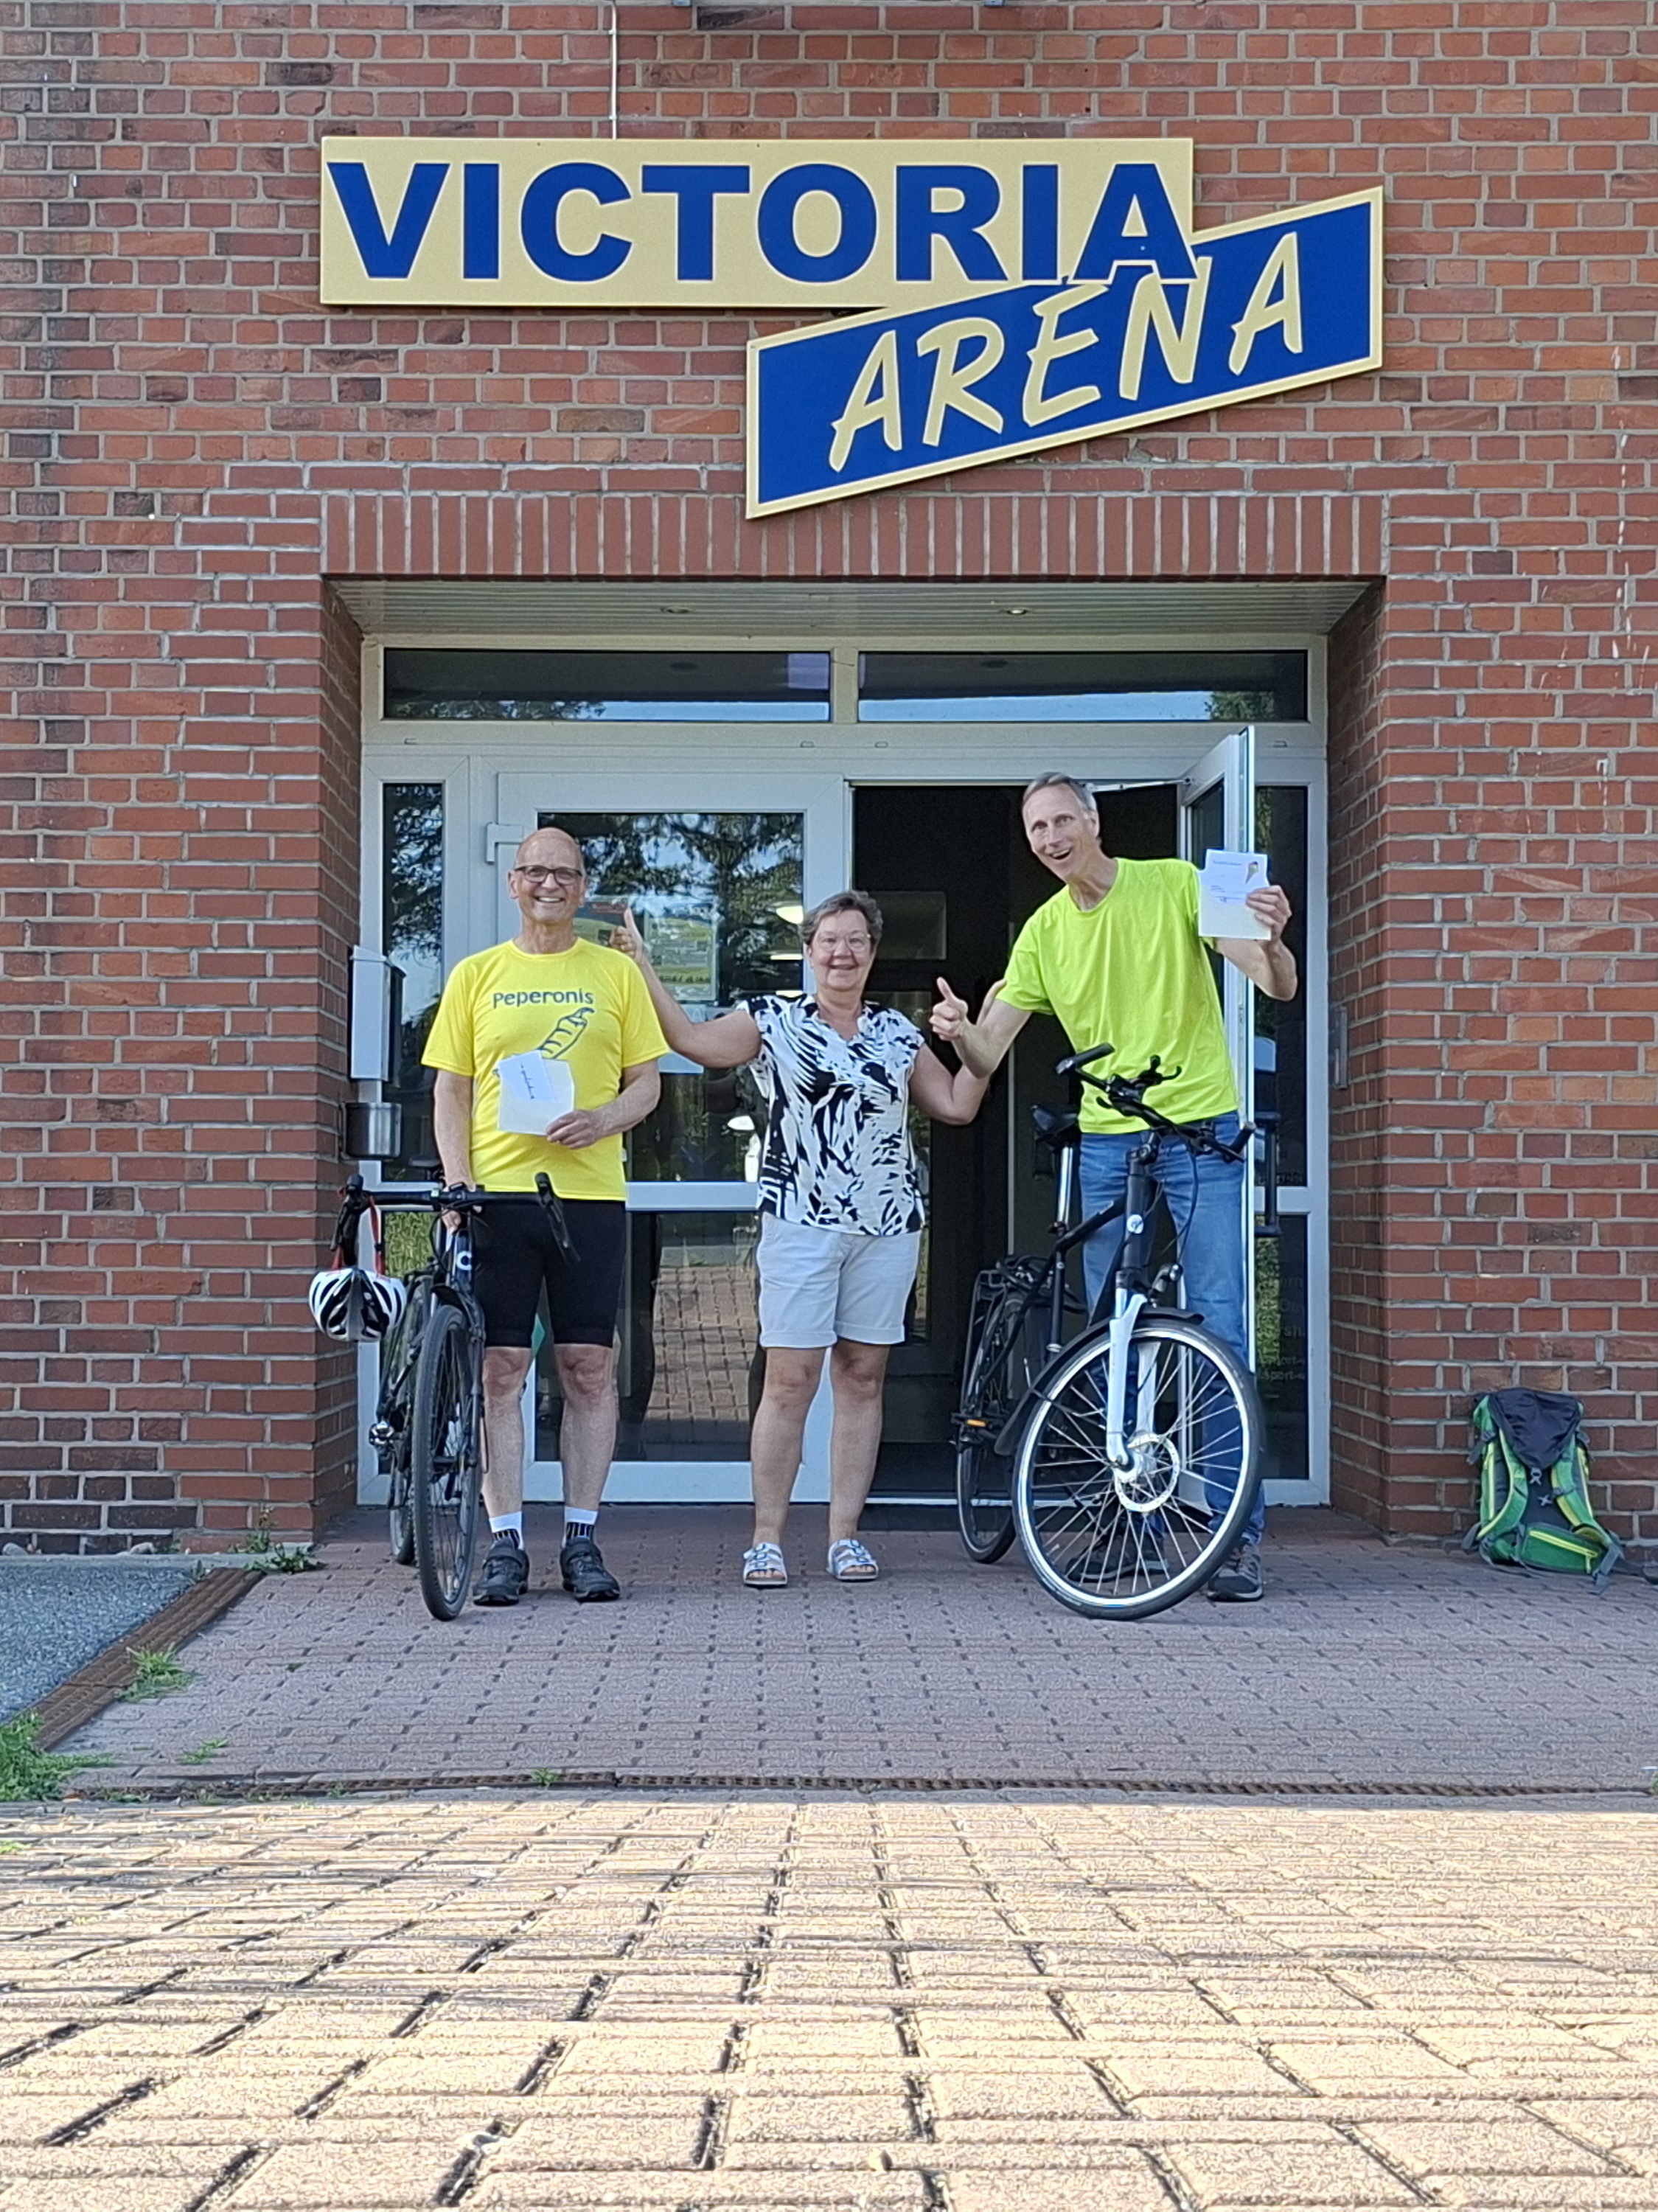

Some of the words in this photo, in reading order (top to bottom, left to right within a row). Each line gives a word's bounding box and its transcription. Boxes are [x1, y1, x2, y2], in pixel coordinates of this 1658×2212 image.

[326, 161, 1197, 285] VICTORIA
[829, 232, 1304, 473] ARENA
[492, 989, 594, 1009] Peperonis
